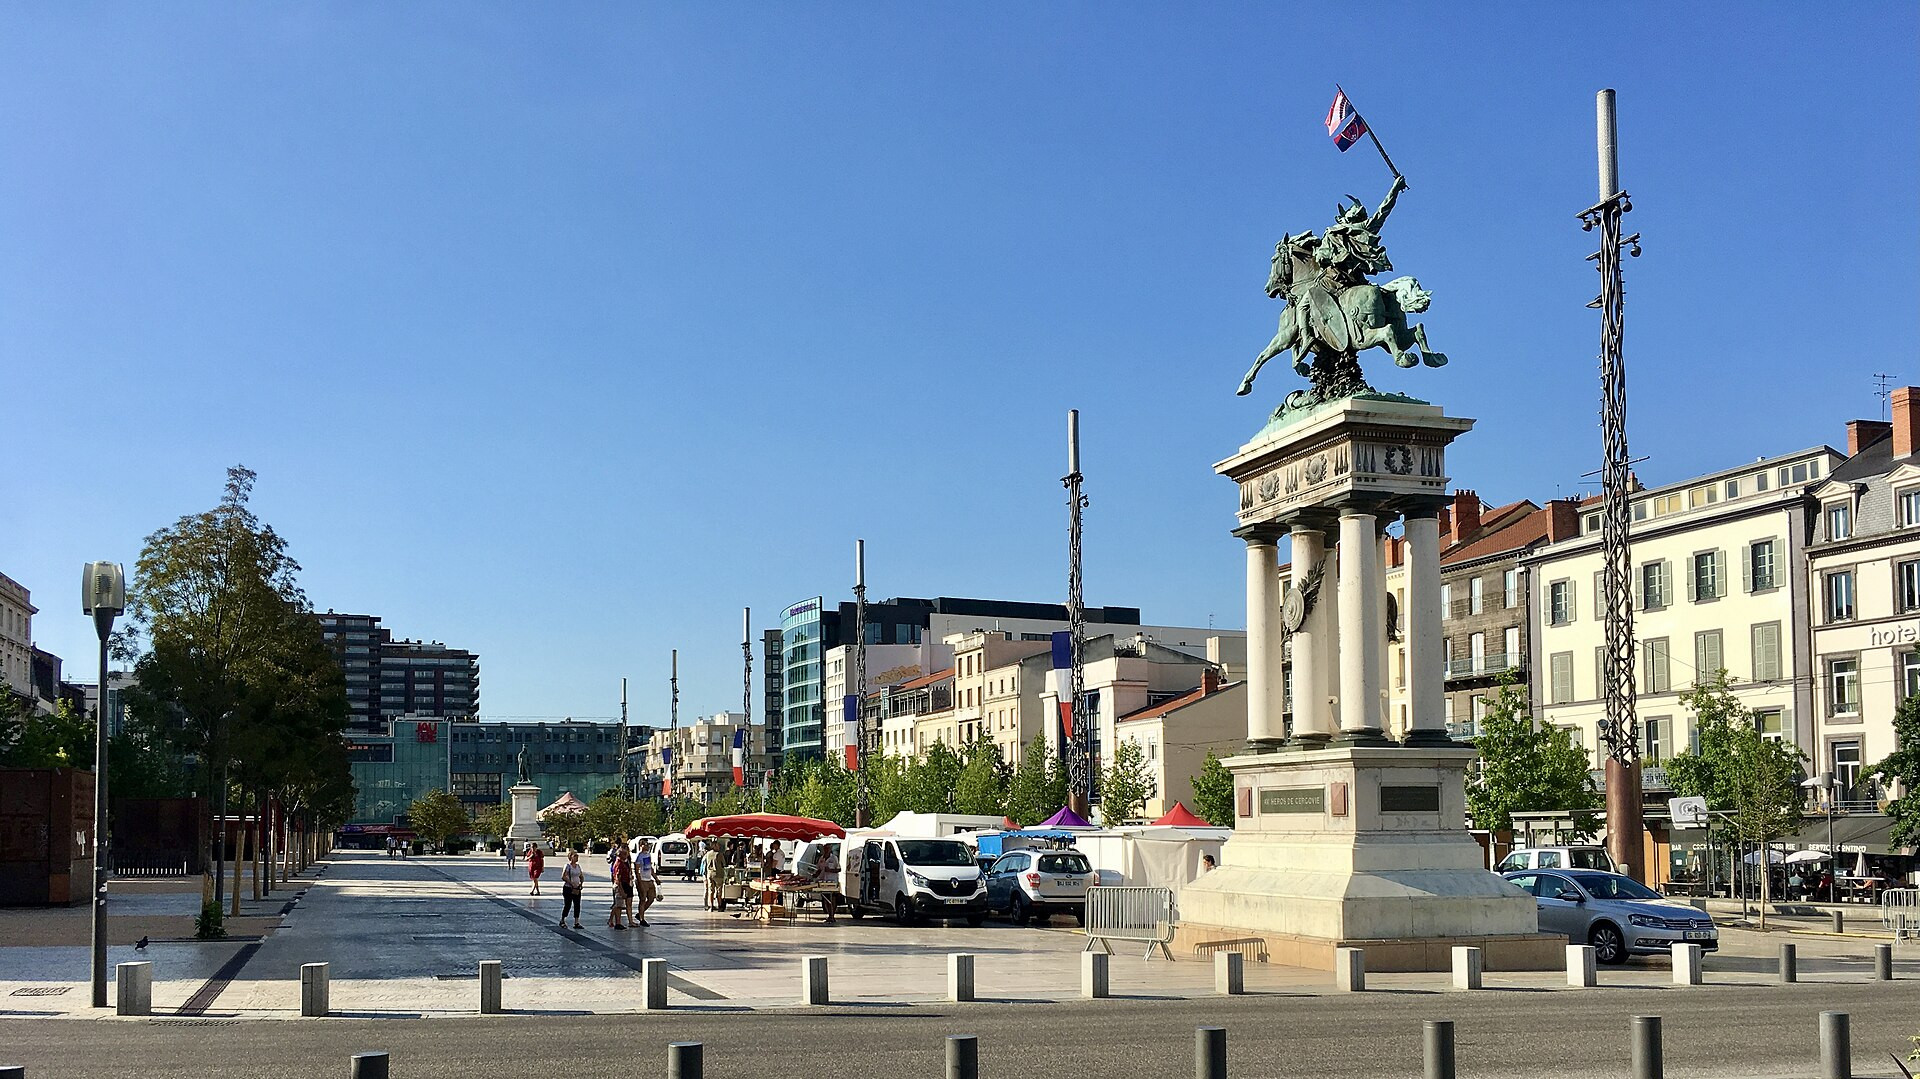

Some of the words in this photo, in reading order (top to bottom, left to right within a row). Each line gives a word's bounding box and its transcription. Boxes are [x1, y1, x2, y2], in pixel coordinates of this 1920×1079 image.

[1870, 621, 1920, 646] hote
[1287, 797, 1294, 805] DE
[1671, 843, 1682, 851] BAR
